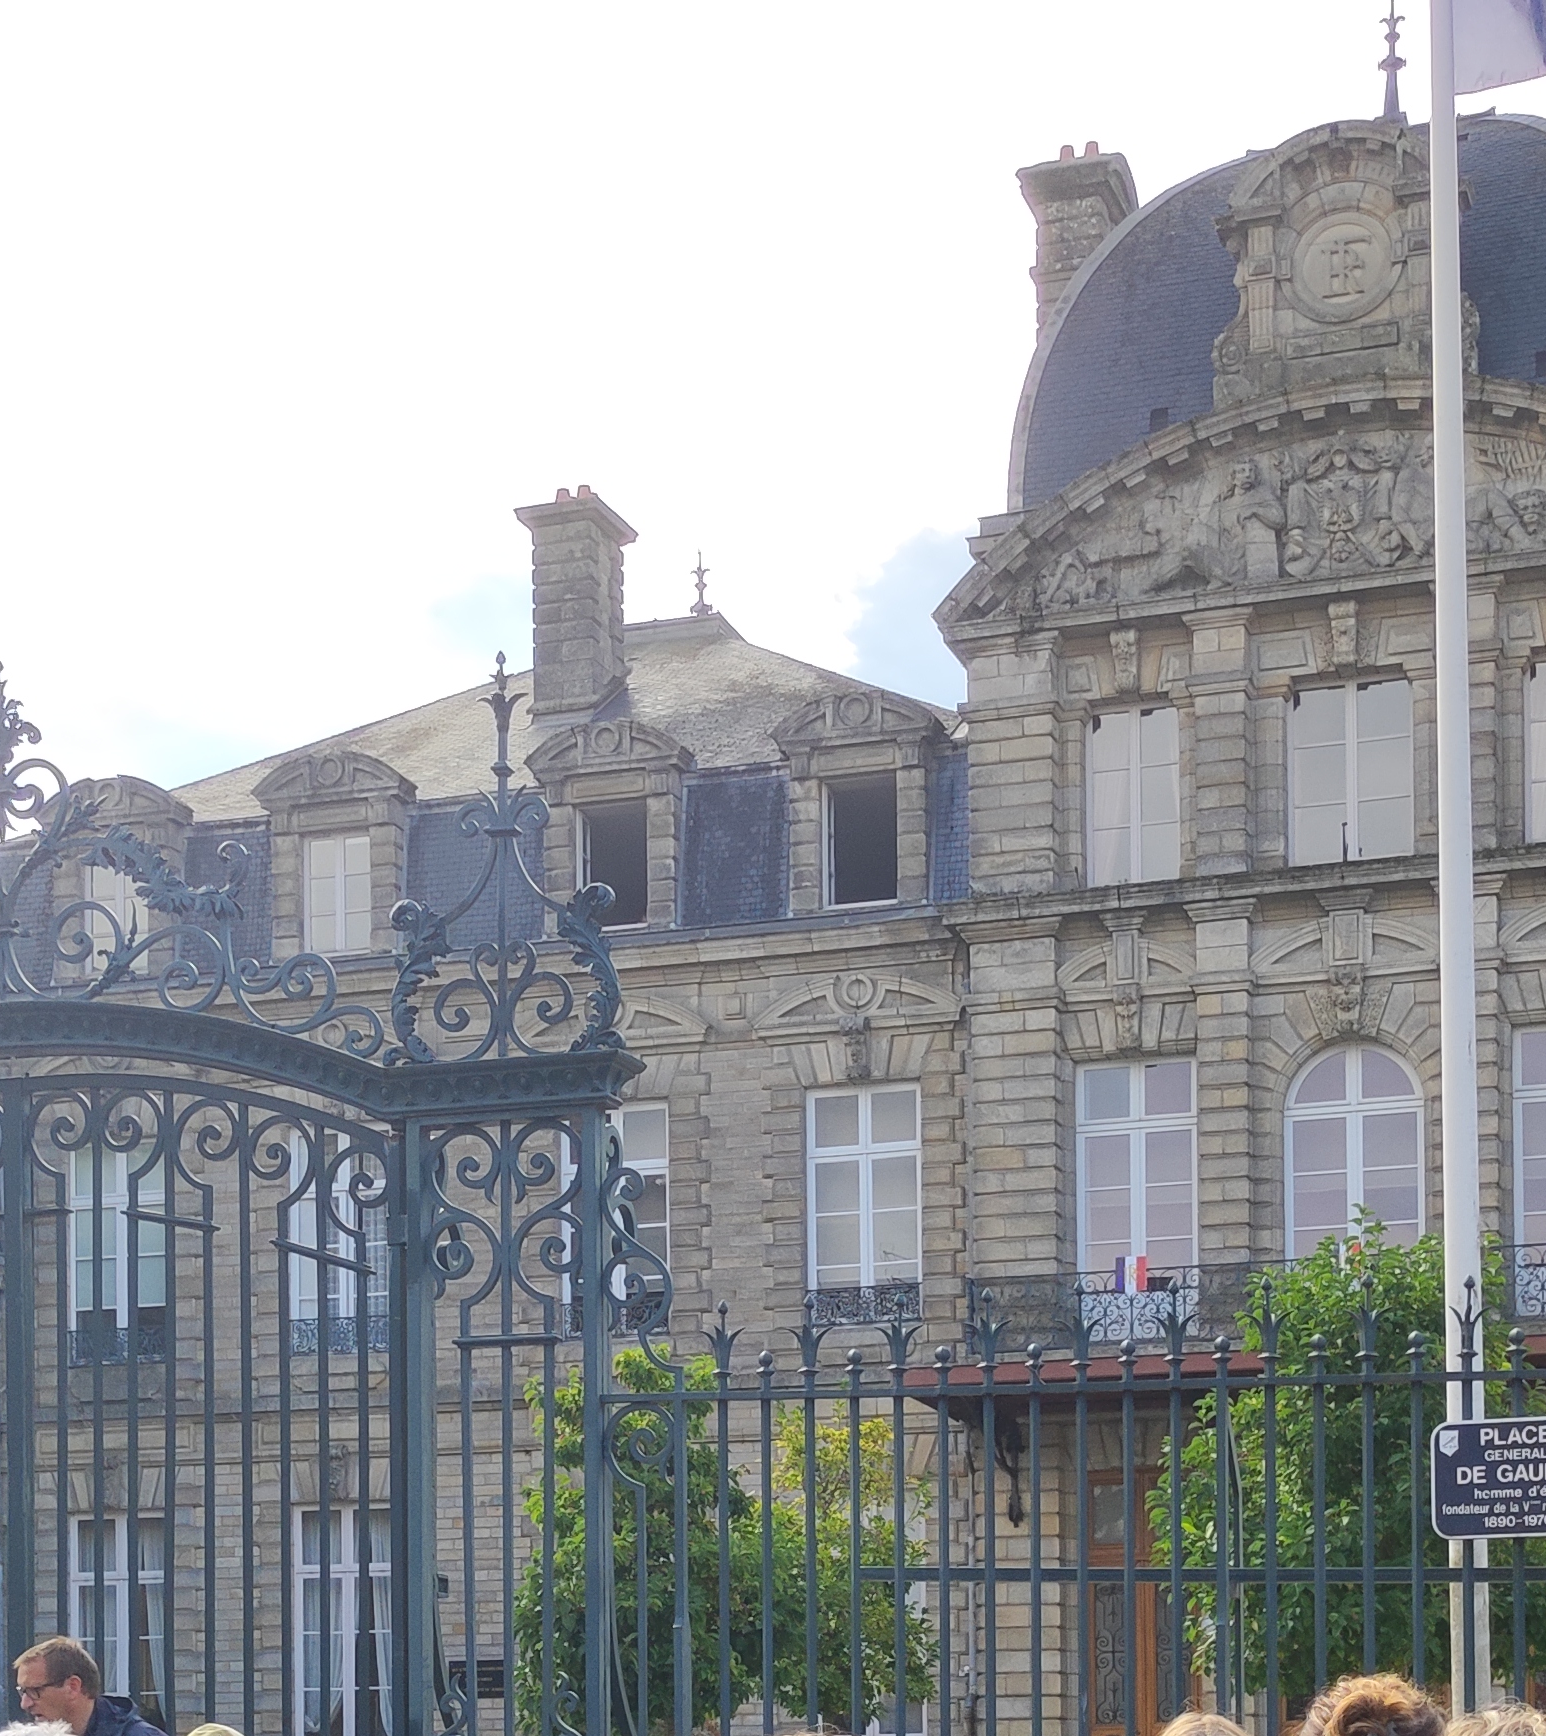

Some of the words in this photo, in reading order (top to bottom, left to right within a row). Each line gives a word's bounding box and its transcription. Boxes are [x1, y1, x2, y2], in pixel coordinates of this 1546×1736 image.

[1456, 1465, 1487, 1485] DE
[1441, 1503, 1490, 1515] fondateur
[1493, 1502, 1507, 1513] de
[1510, 1501, 1519, 1513] la
